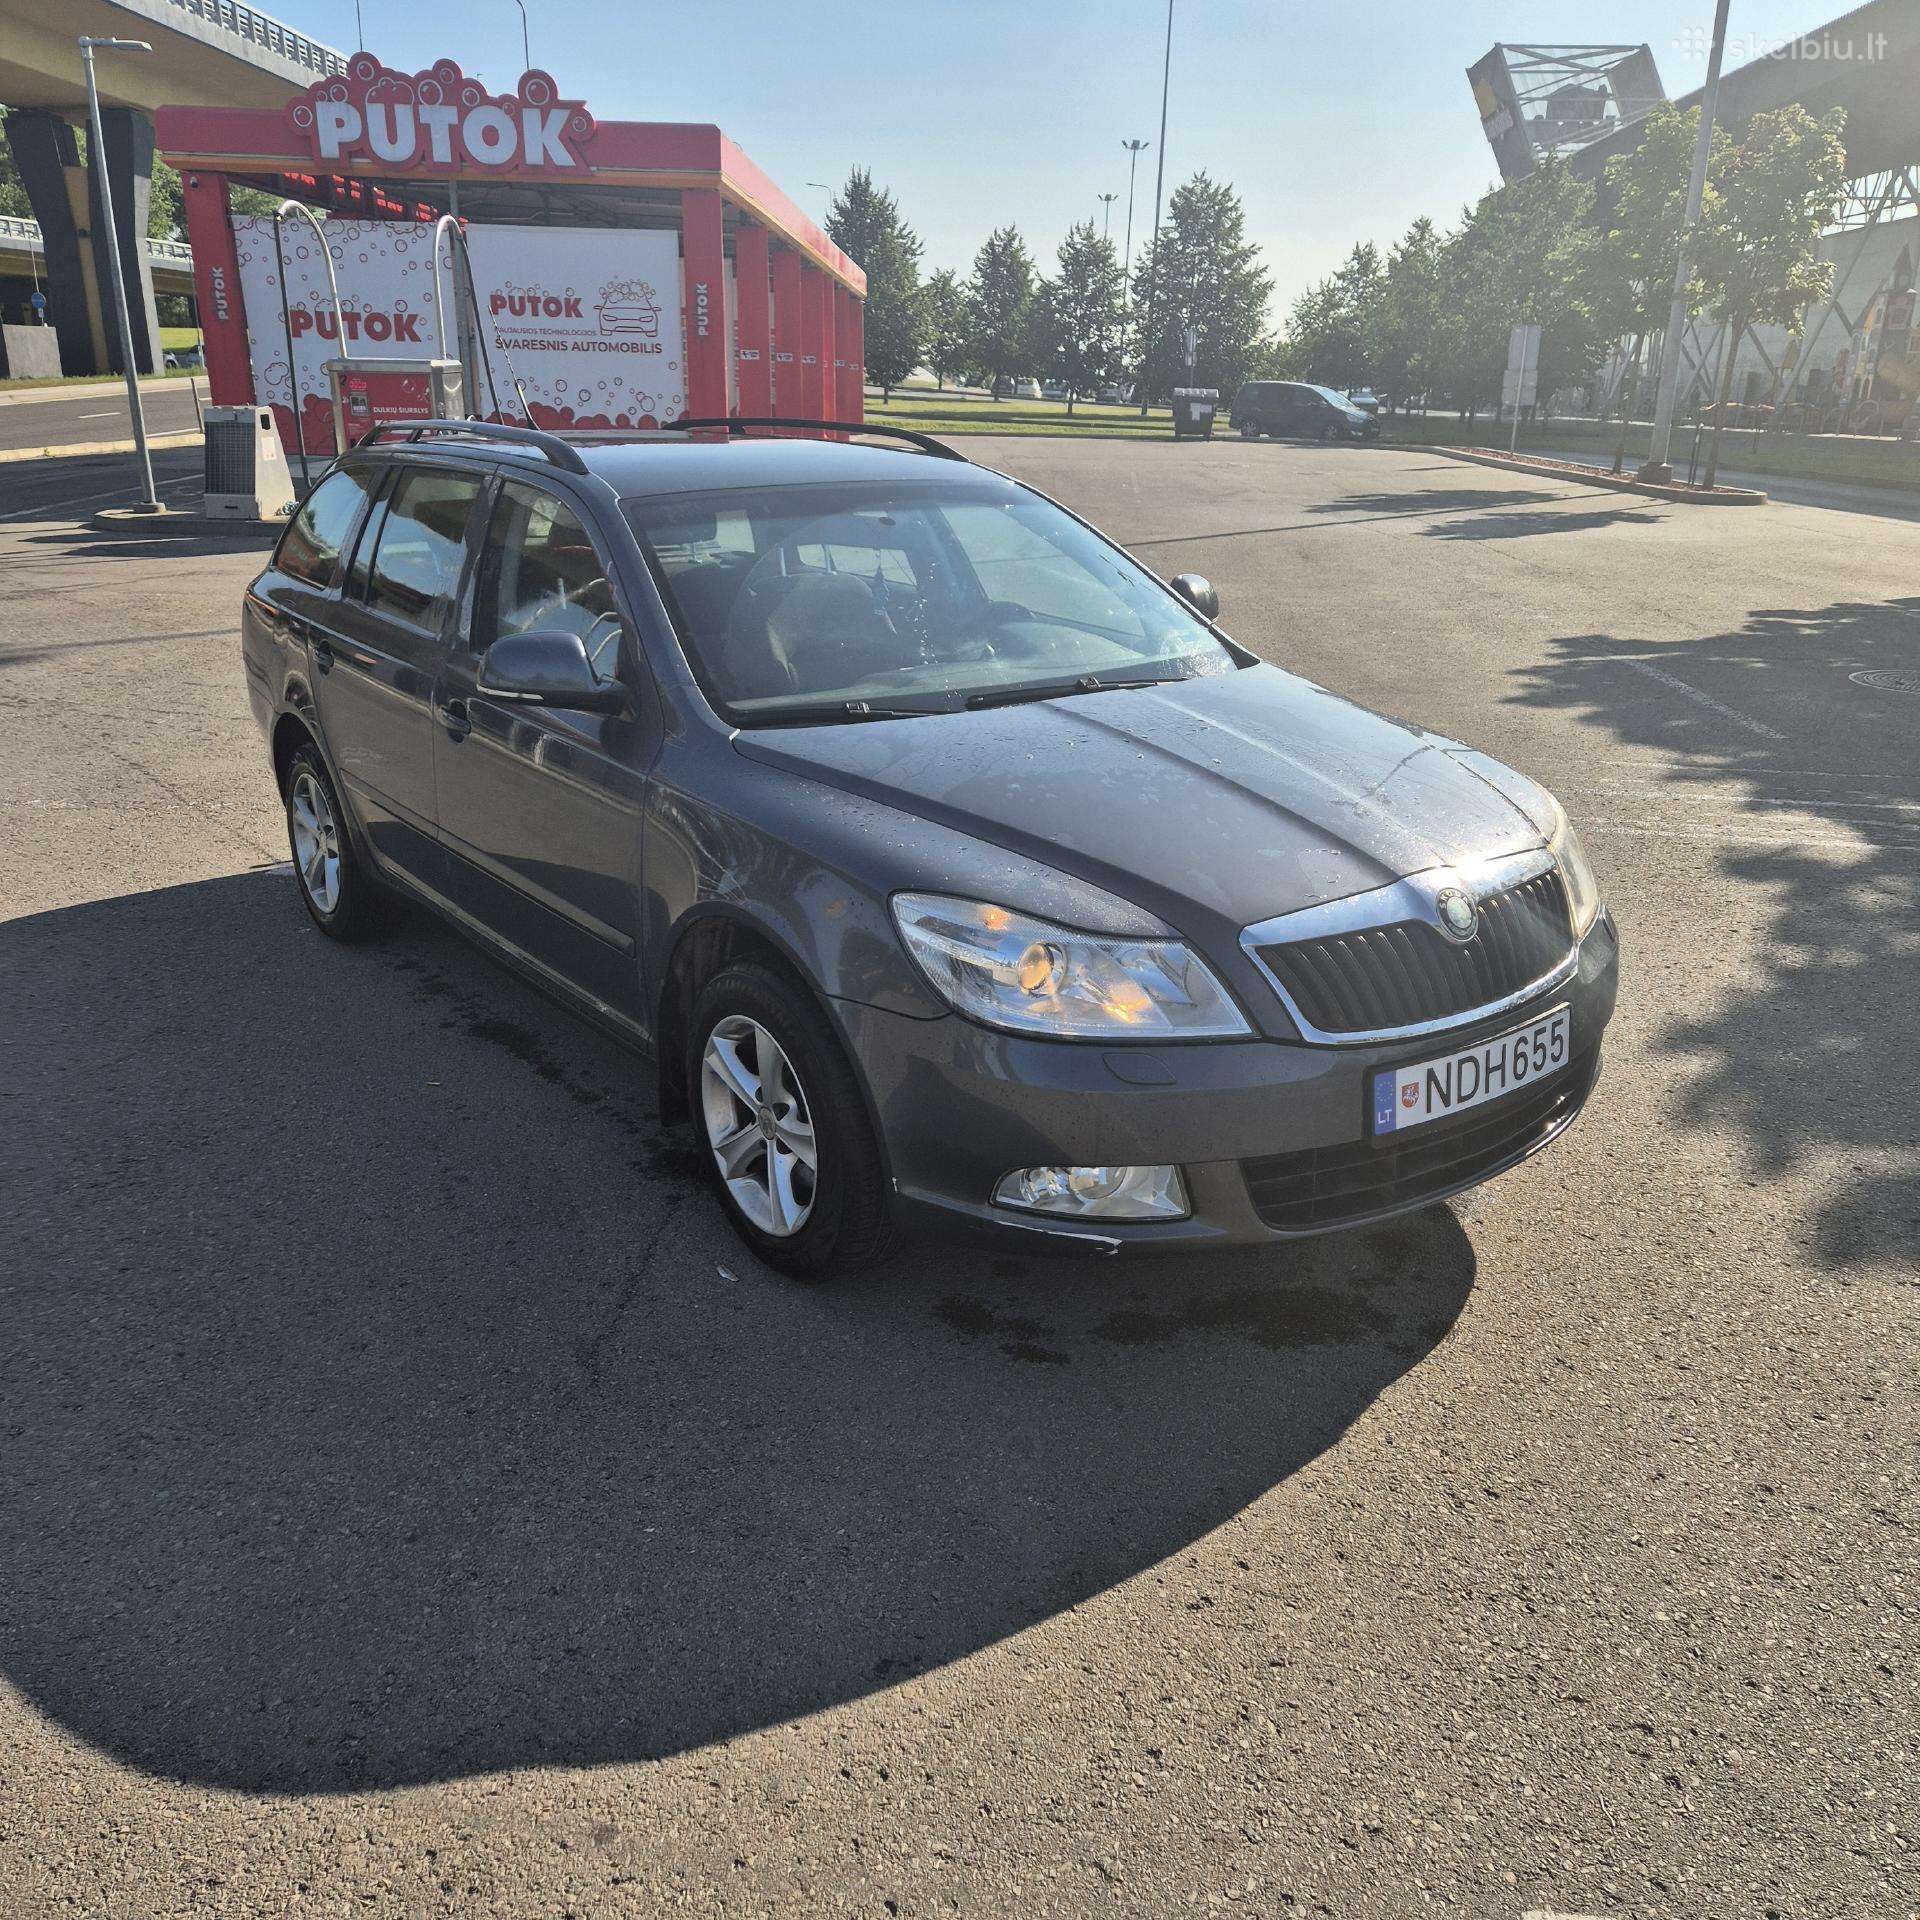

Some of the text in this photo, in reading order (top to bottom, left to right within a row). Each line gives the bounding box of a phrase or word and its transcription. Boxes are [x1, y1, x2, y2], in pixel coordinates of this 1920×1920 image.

[315, 100, 576, 167] PUTOK
[211, 266, 229, 321] PUTOK
[489, 294, 584, 319] PUTOK
[696, 283, 709, 336] PUTOK
[289, 310, 422, 342] PUTOK
[495, 334, 663, 354] ŠVARESNIS AUTOMOBILIS
[1426, 1020, 1564, 1114] NDH655
[1378, 1109, 1393, 1125] LT
